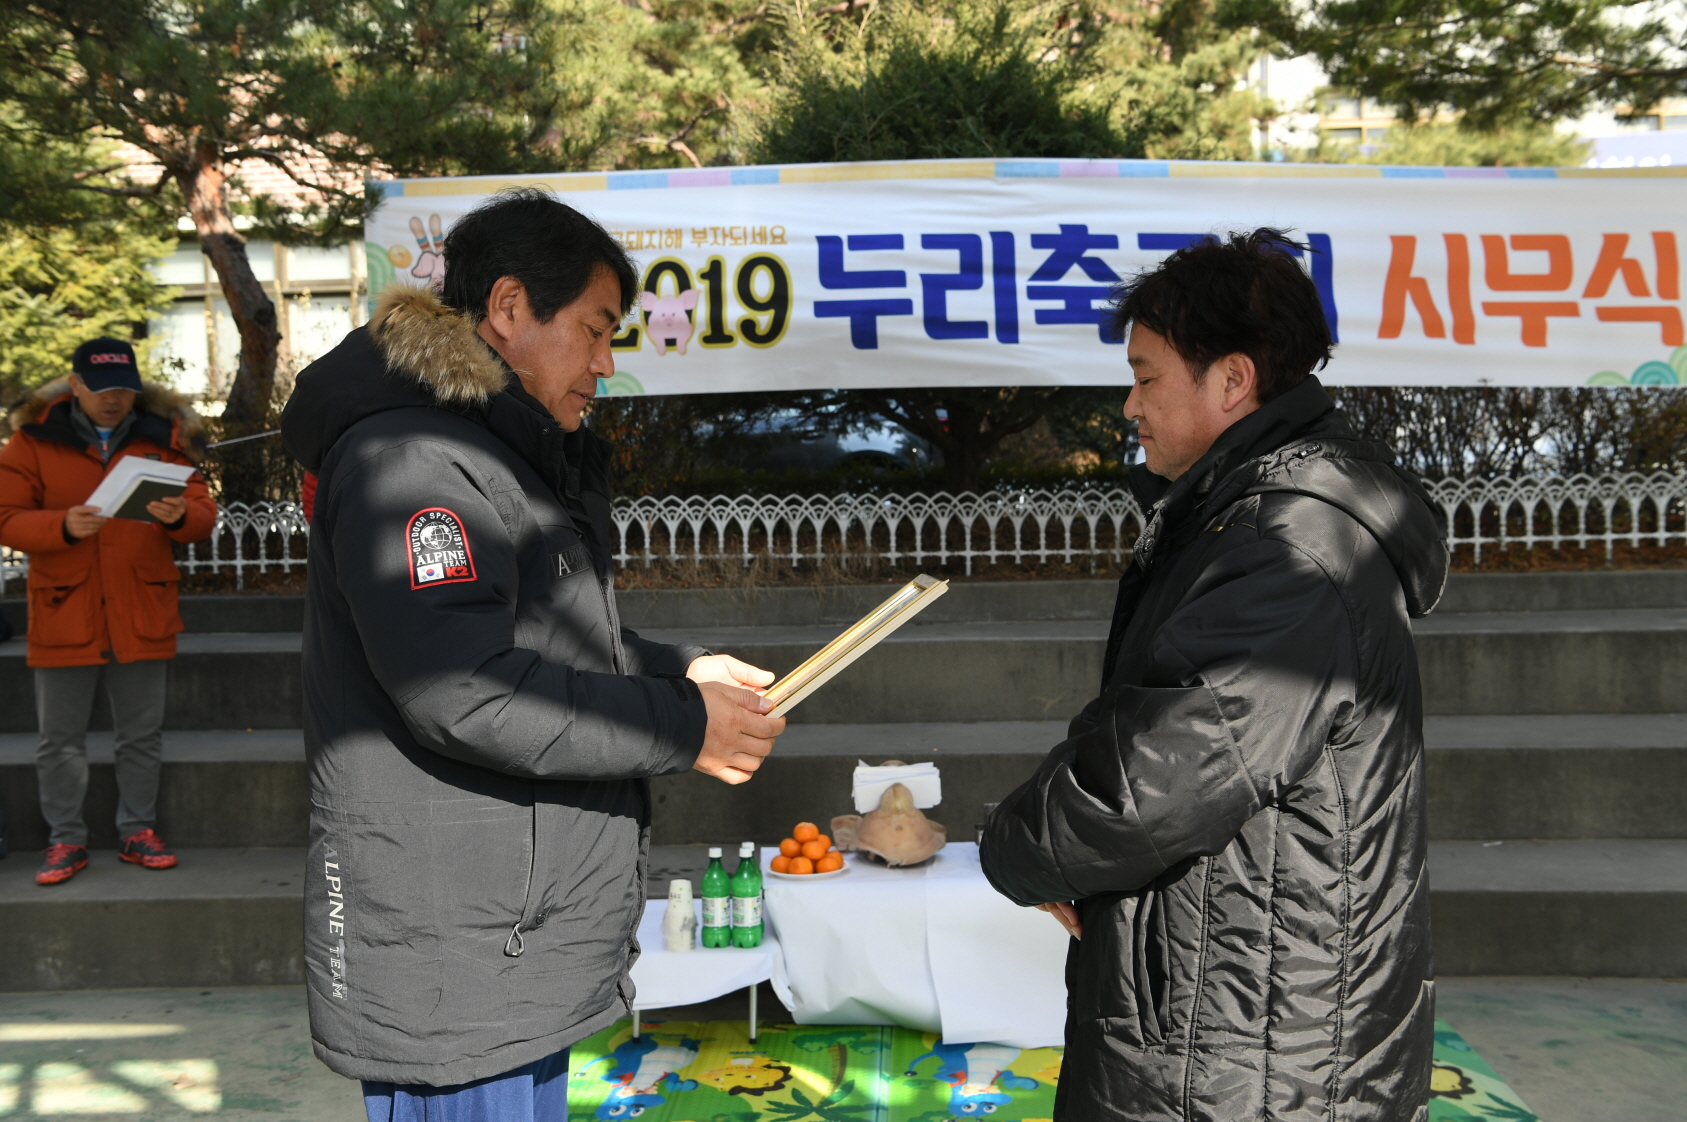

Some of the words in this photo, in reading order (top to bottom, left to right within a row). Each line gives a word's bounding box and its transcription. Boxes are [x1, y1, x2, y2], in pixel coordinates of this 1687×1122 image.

[690, 225, 788, 248] 부자되세요
[813, 223, 1339, 349] 두리축
[1377, 231, 1685, 348] 시무식
[411, 516, 427, 553] OUTDOOR
[429, 512, 463, 548] SPECIALIST
[416, 550, 466, 567] ALPINE
[443, 559, 467, 568] TEAM
[445, 566, 469, 577] K2
[322, 841, 345, 937] ALPINE
[329, 946, 344, 1000] TEAM
